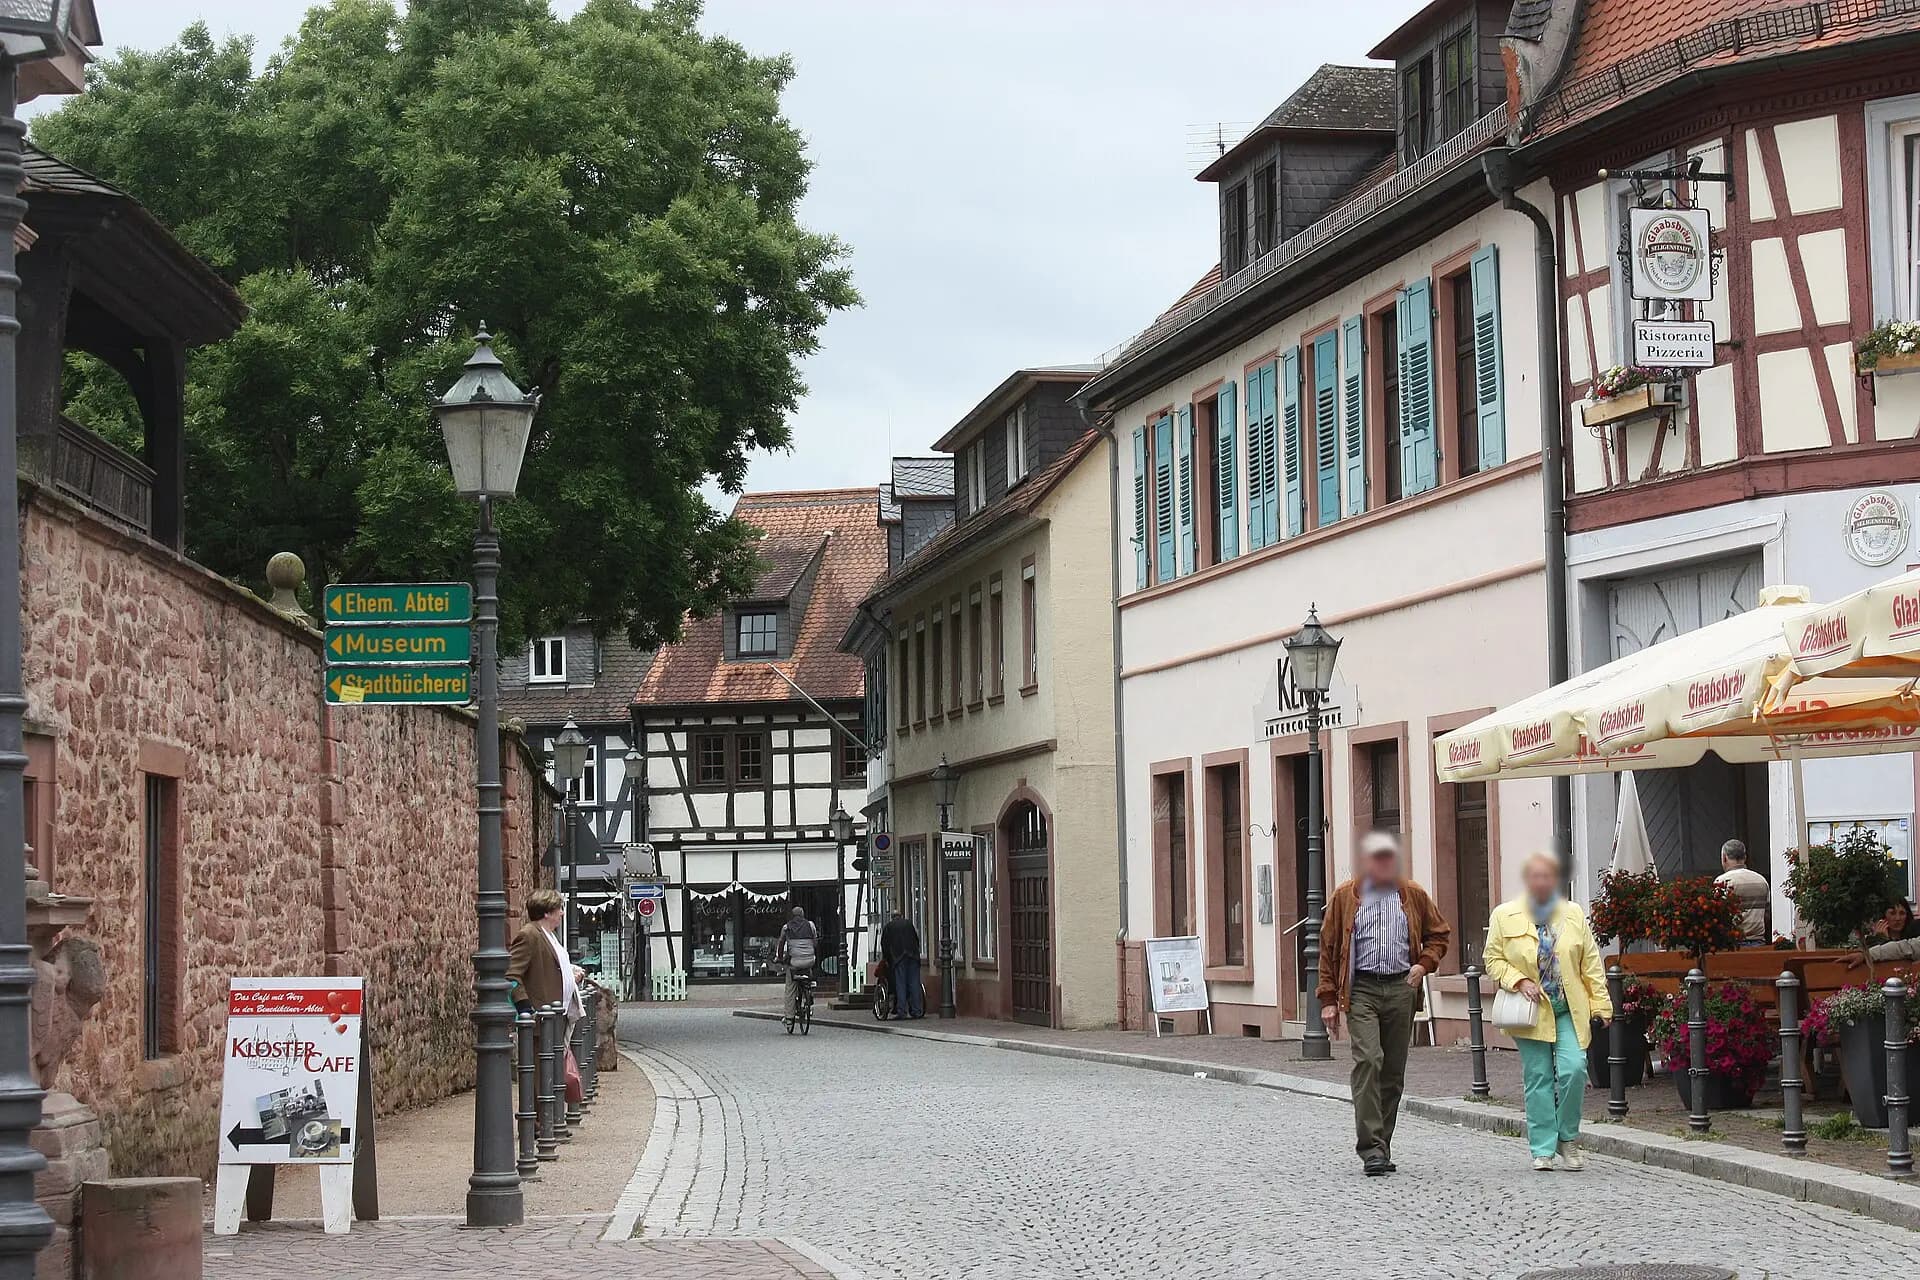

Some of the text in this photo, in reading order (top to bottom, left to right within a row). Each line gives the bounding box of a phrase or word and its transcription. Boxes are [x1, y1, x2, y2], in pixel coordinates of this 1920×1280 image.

[1648, 219, 1692, 243] Glaabsbräu
[1639, 329, 1711, 341] Ristorante
[1647, 345, 1704, 358] Pizzeria
[1853, 495, 1896, 519] Glaabsbräu
[346, 592, 449, 613] Ehem. Abtei
[1892, 590, 1920, 629] Glaa
[346, 633, 446, 654] Museum
[345, 673, 467, 694] Stadtbücherei
[234, 992, 304, 1003] Das Café mit Herz
[242, 1005, 254, 1013] der
[256, 1004, 325, 1013] Benediktiner-Abtei
[231, 1038, 316, 1058] KLOSTER
[304, 1051, 355, 1073] CAFE
